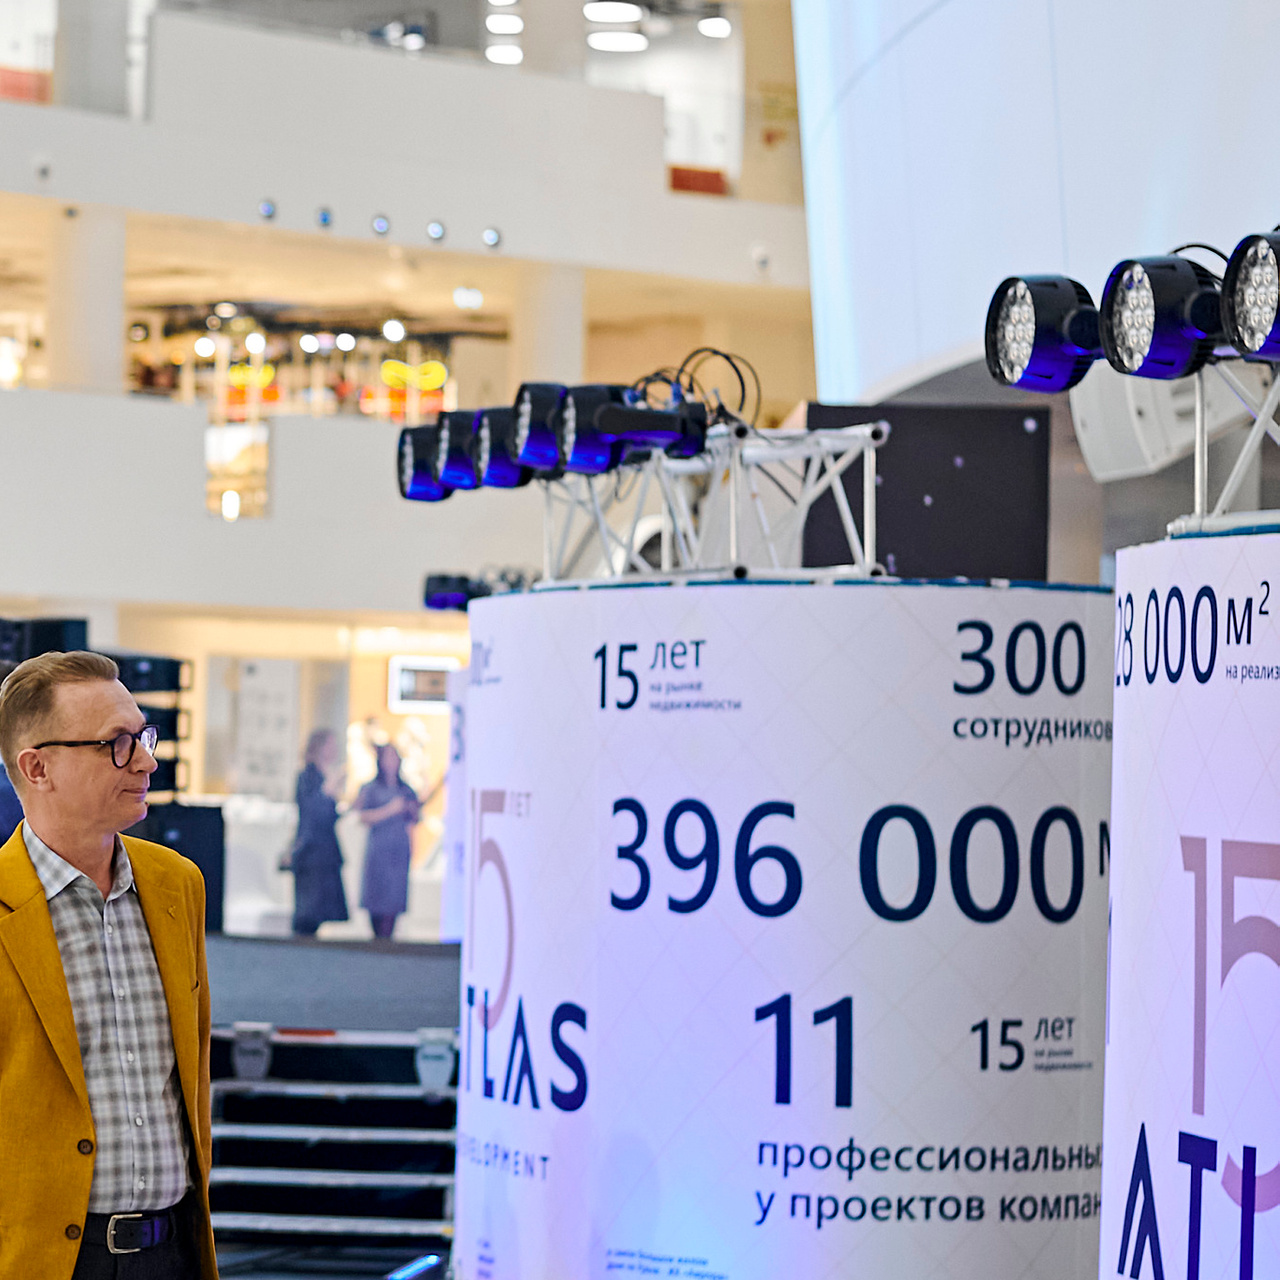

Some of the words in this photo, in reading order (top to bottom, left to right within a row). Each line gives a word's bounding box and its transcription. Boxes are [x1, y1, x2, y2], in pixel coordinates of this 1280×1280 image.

[650, 640, 706, 670] лет
[953, 620, 1087, 695] 300
[1144, 584, 1218, 685] 000
[594, 643, 639, 710] 15
[953, 718, 1112, 747] сотрудников
[610, 797, 803, 919] 396
[858, 803, 1085, 925] 000
[754, 993, 854, 1107] 11
[971, 1018, 1025, 1072] 15
[1034, 1017, 1075, 1041] лет
[756, 1191, 775, 1225] у
[790, 1194, 985, 1230] проектов
